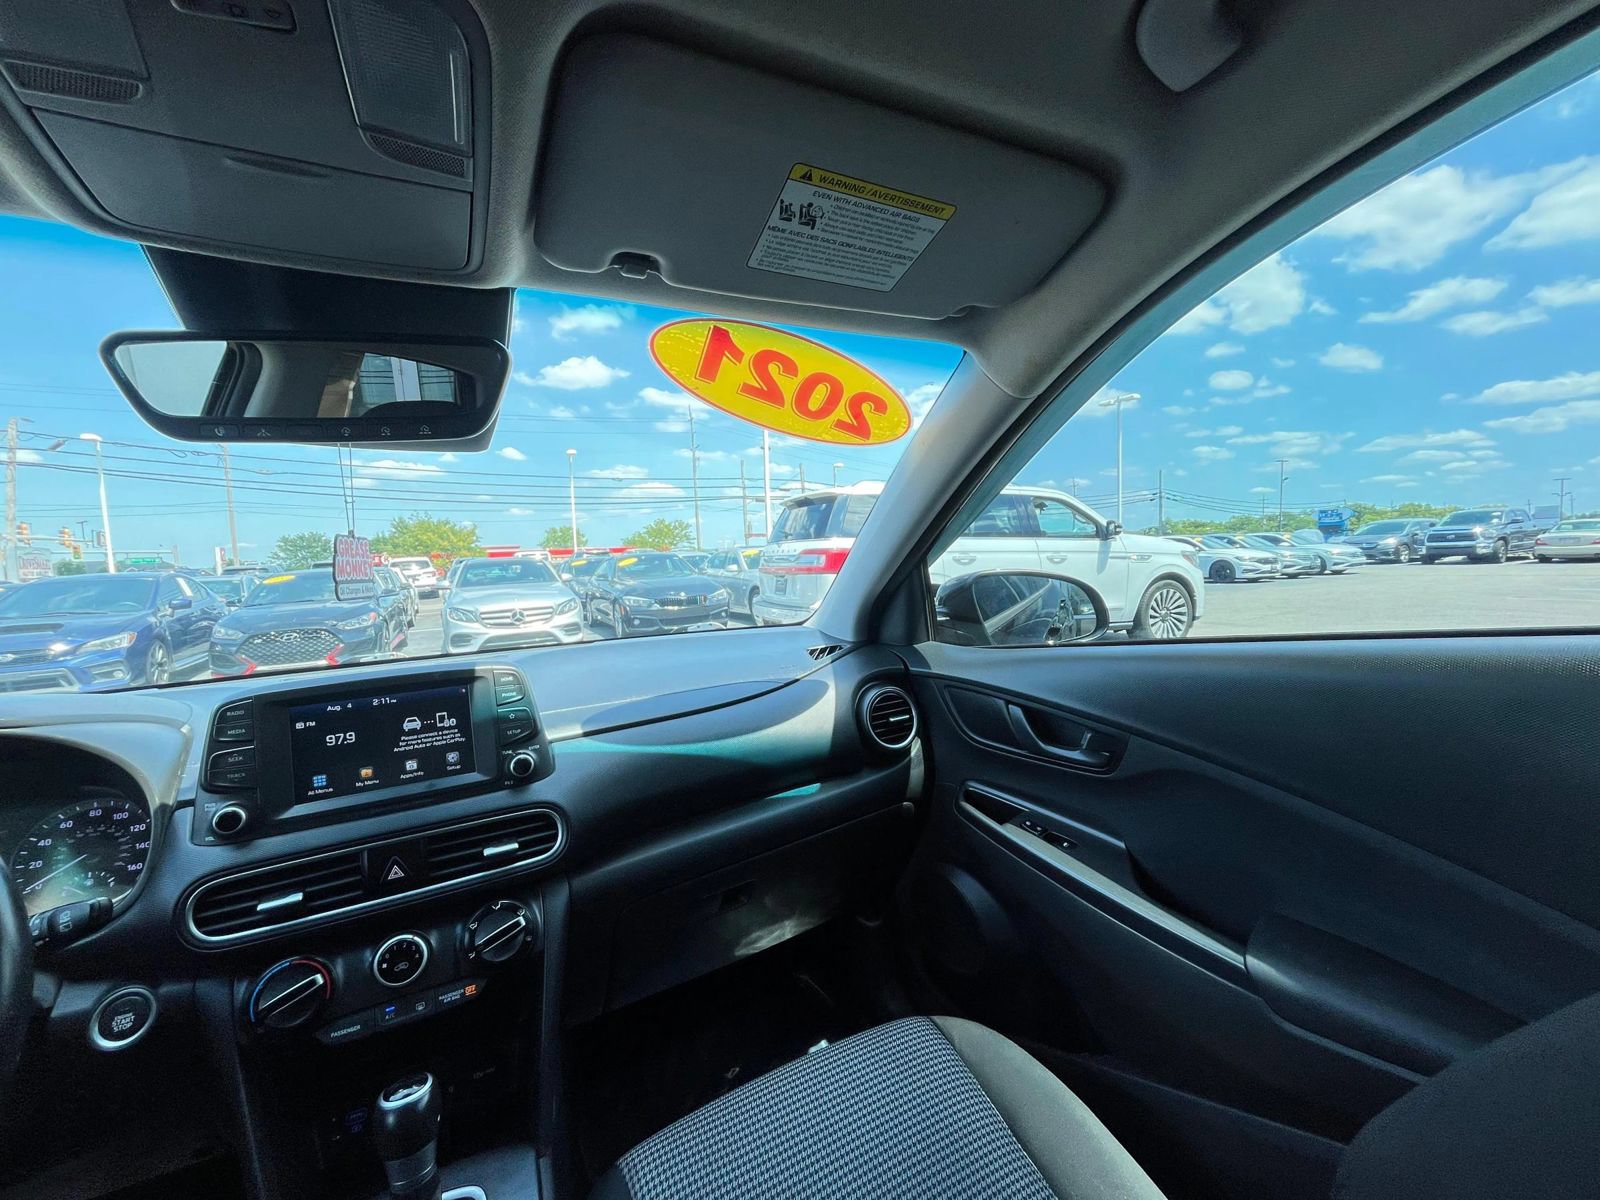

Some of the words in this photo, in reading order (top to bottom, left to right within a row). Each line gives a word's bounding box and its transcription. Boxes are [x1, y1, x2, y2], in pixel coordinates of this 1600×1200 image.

[818, 174, 866, 194] WARNING
[871, 190, 946, 216] AVERTISSEMENT
[812, 190, 832, 201] EVEN
[833, 194, 852, 205] WITH
[851, 199, 889, 215] ADVANCED
[889, 209, 902, 218] AIR
[902, 213, 921, 223] BAGS
[788, 230, 806, 239] AVEC
[806, 234, 820, 242] DES
[820, 236, 837, 246] SACS
[338, 537, 369, 559] GREASE
[336, 559, 374, 579] MONKEY
[326, 731, 356, 746] 97.9
[89, 809, 102, 817] 80
[113, 812, 129, 820] 100
[60, 820, 73, 829] 60
[130, 824, 146, 832] 120
[38, 838, 52, 846] 40
[136, 841, 150, 849] 140
[28, 860, 43, 869] 20
[127, 863, 143, 872] 160
[438, 988, 464, 1000] PASSENGER
[112, 1016, 136, 1028] START
[114, 1022, 133, 1032] STOP
[330, 1025, 360, 1038] PASSENGER
